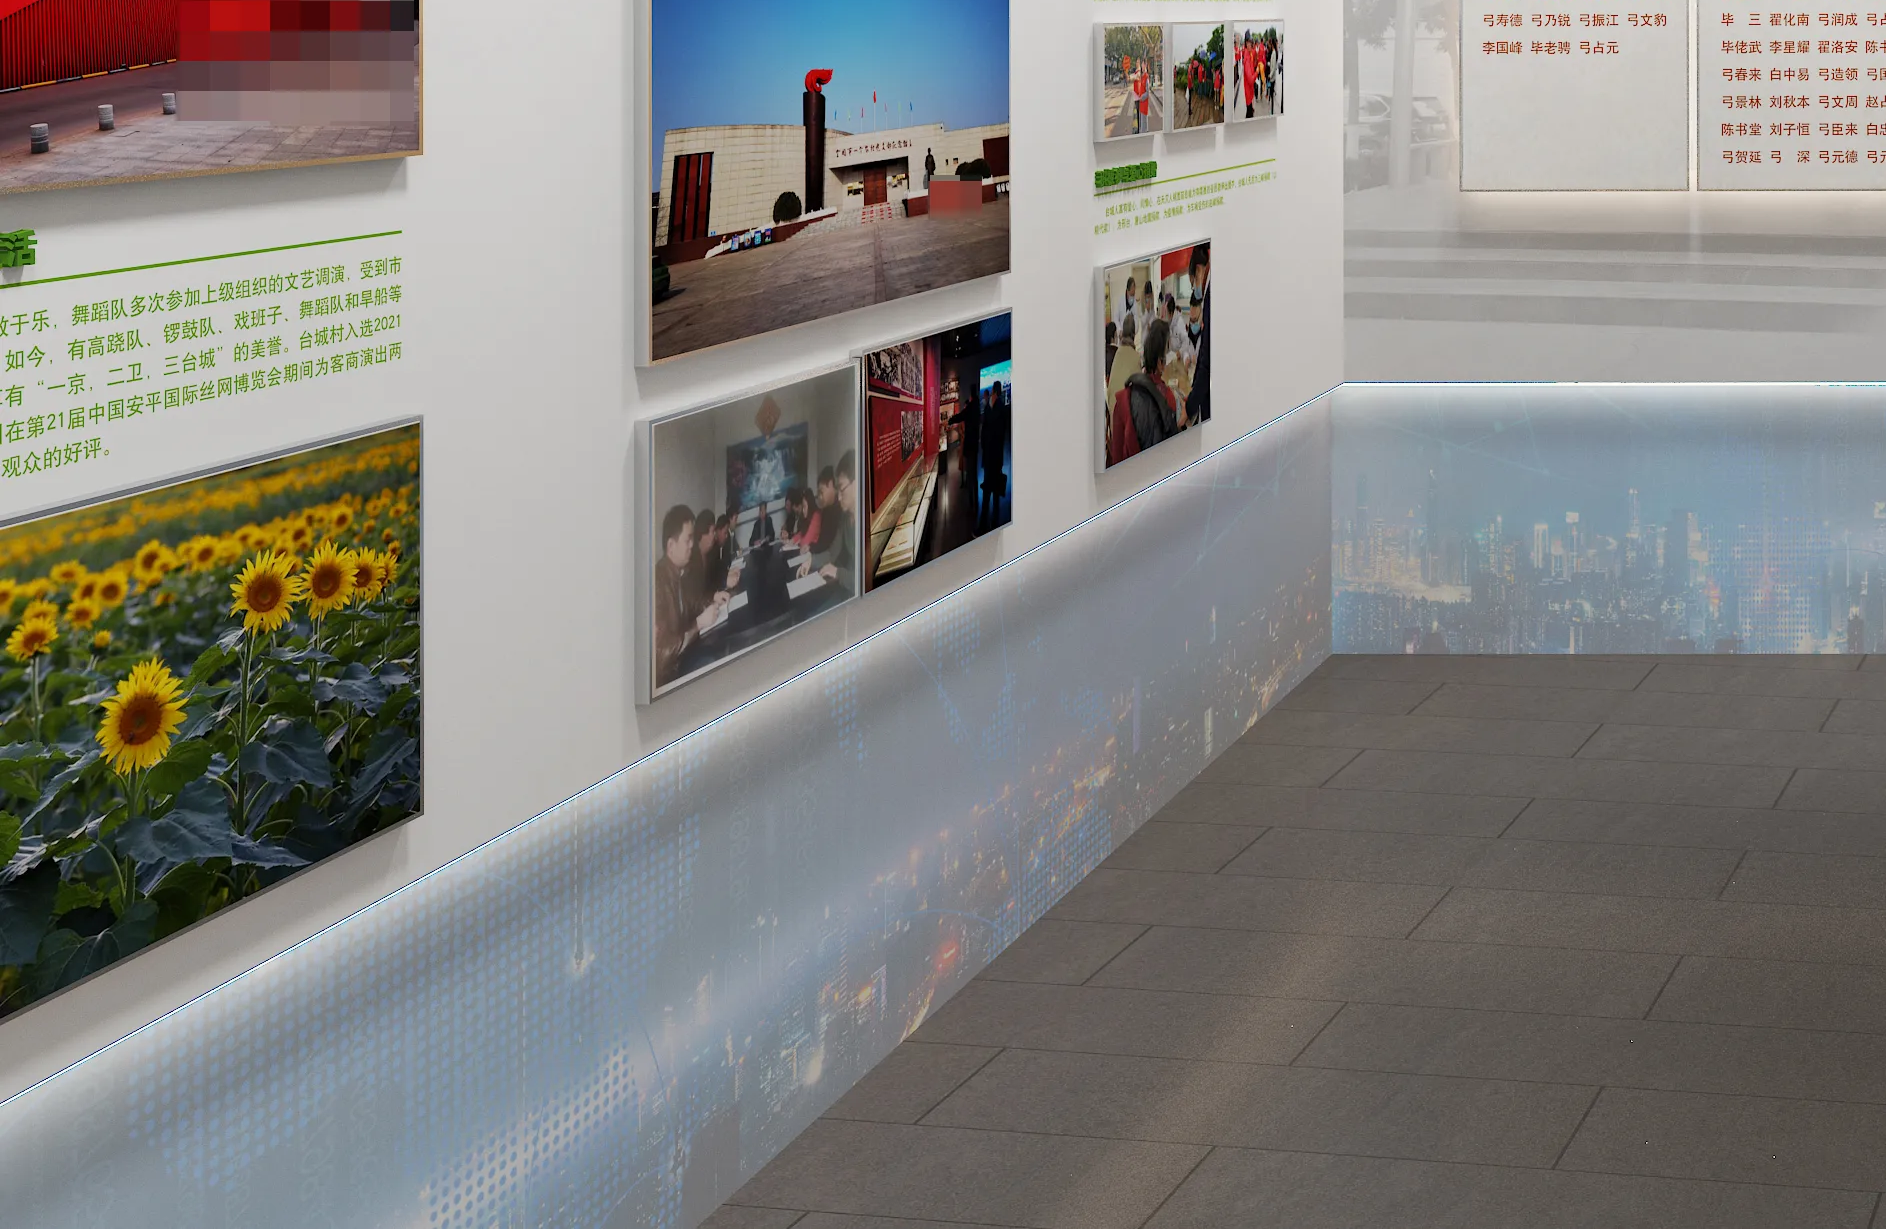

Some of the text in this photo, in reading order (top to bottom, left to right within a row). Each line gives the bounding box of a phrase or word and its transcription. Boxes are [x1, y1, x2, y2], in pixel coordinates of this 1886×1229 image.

[1483, 13, 1667, 28] 弓寿德 弓乃锐 弓振江 弓文豹
[1769, 12, 1810, 28] 翟化南
[1817, 12, 1858, 28] 弓润成
[1481, 40, 1523, 56] 李国峰
[1579, 40, 1619, 56] 弓占元
[1769, 39, 1810, 55] 李星耀
[1817, 39, 1858, 55] 翟洛安
[1721, 67, 1762, 82] 弓春来
[1769, 67, 1810, 82] 白中易
[1817, 67, 1858, 82] 弓造领
[1721, 94, 1762, 110] 弓景林
[1769, 94, 1810, 110] 刘秋本
[1817, 94, 1858, 110] 弓文周
[1721, 122, 1762, 137] 陈书堂
[1769, 122, 1810, 137] 刘子恒
[1817, 122, 1858, 137] 弓臣来
[1721, 149, 1762, 165] 弓贺延
[1817, 149, 1858, 165] 弓元德
[0, 316, 402, 407] 有“一京，二卫，三台城”的美誉。台城村入选2021
[0, 342, 402, 444] 在第21届中国安平国际丝网博览会期间为客商演出两
[2, 438, 112, 478] 观众的好评。
